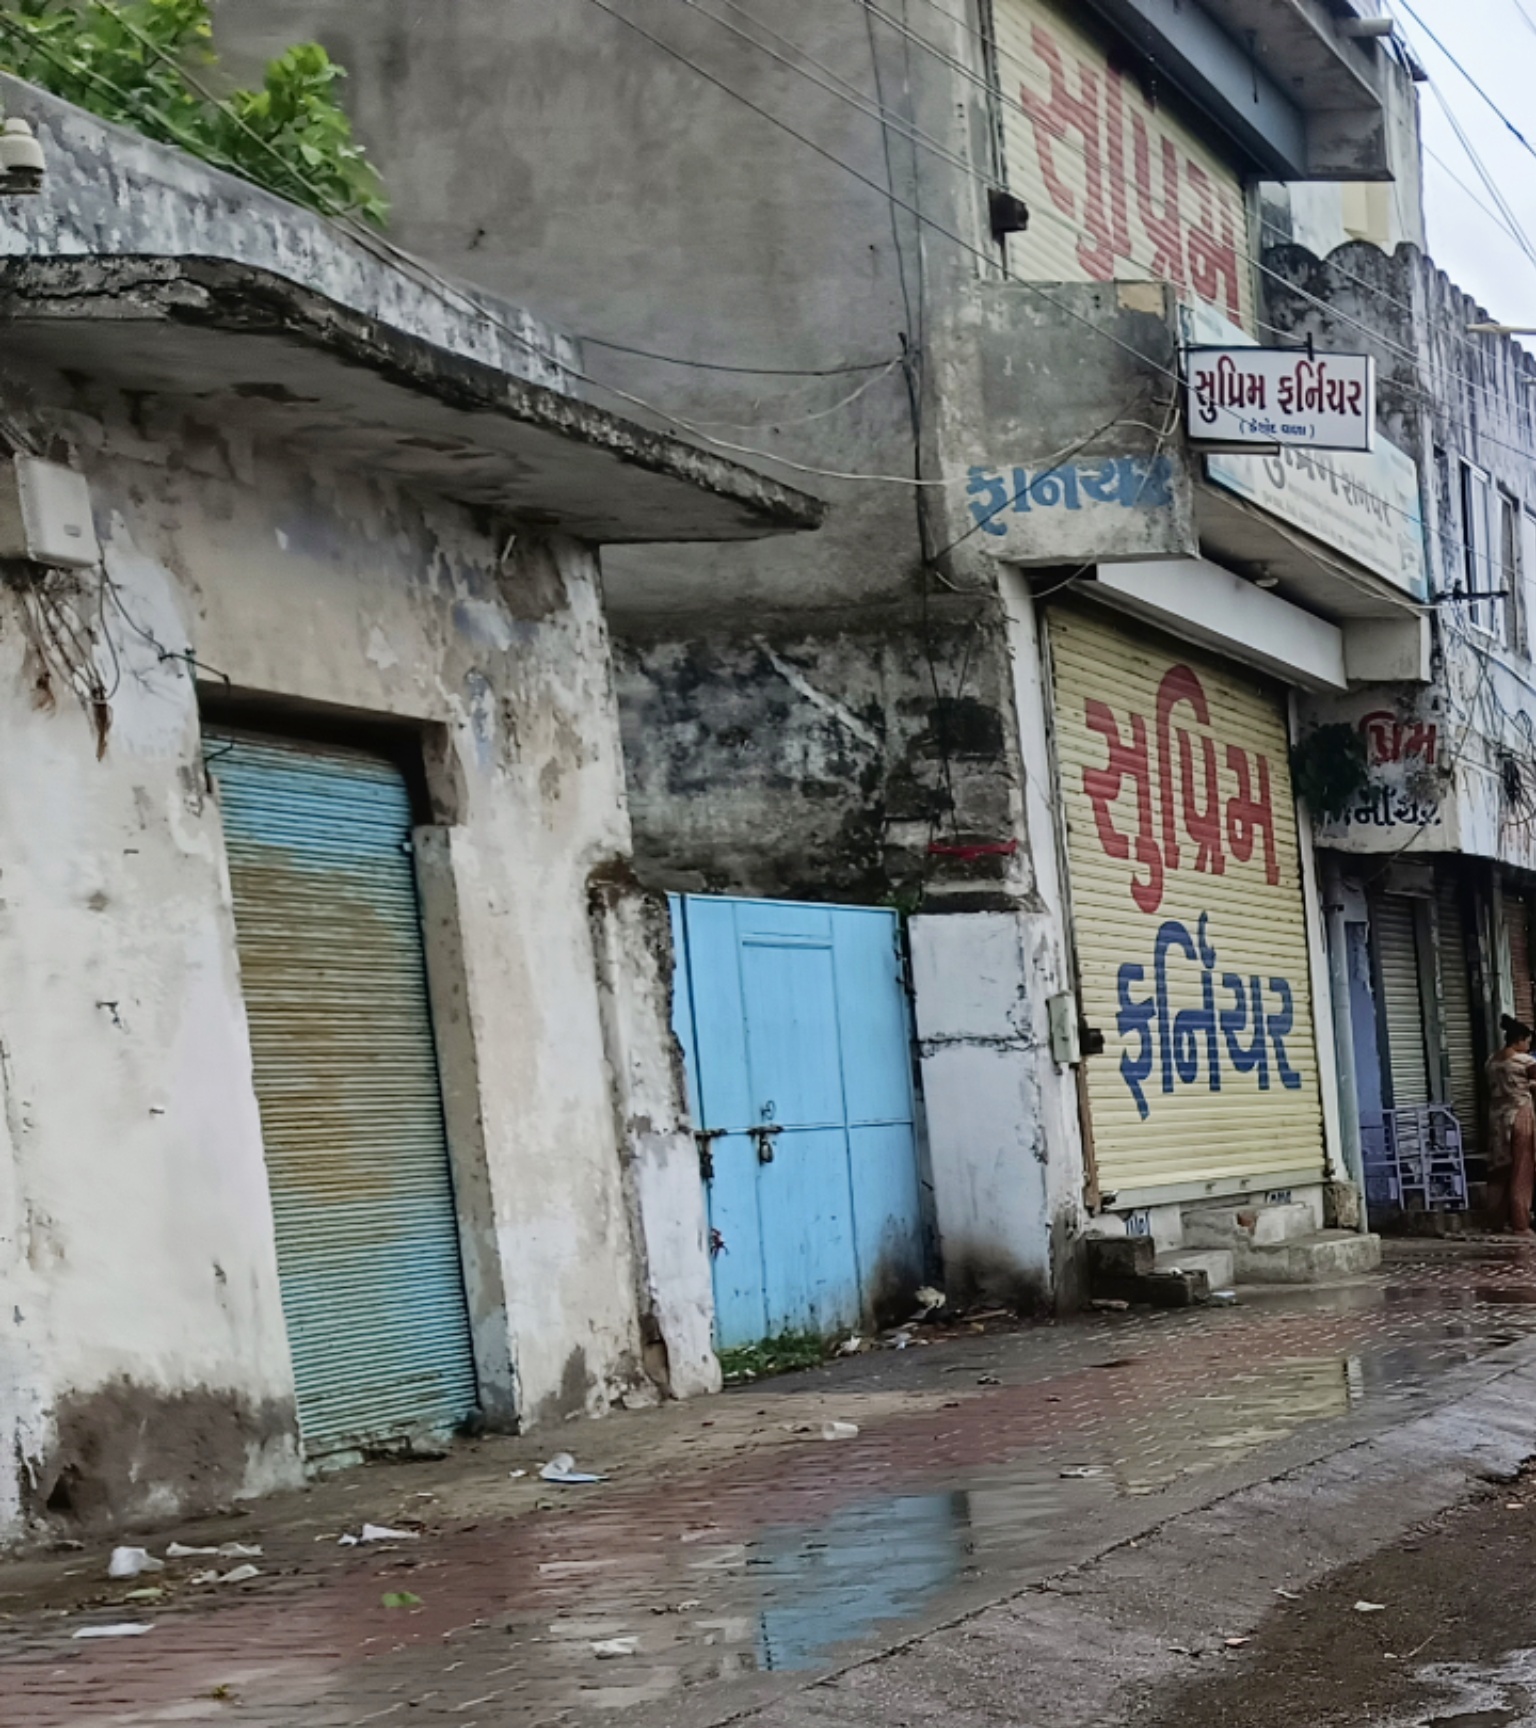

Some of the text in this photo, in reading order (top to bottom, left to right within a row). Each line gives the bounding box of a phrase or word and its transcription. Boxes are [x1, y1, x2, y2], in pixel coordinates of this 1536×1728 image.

[1195, 354, 1362, 423] સુપ્રિમ ફર્નિચર
[1082, 663, 1280, 914] સુપ્રિમ
[1116, 910, 1302, 1121] ફર્નિચર
